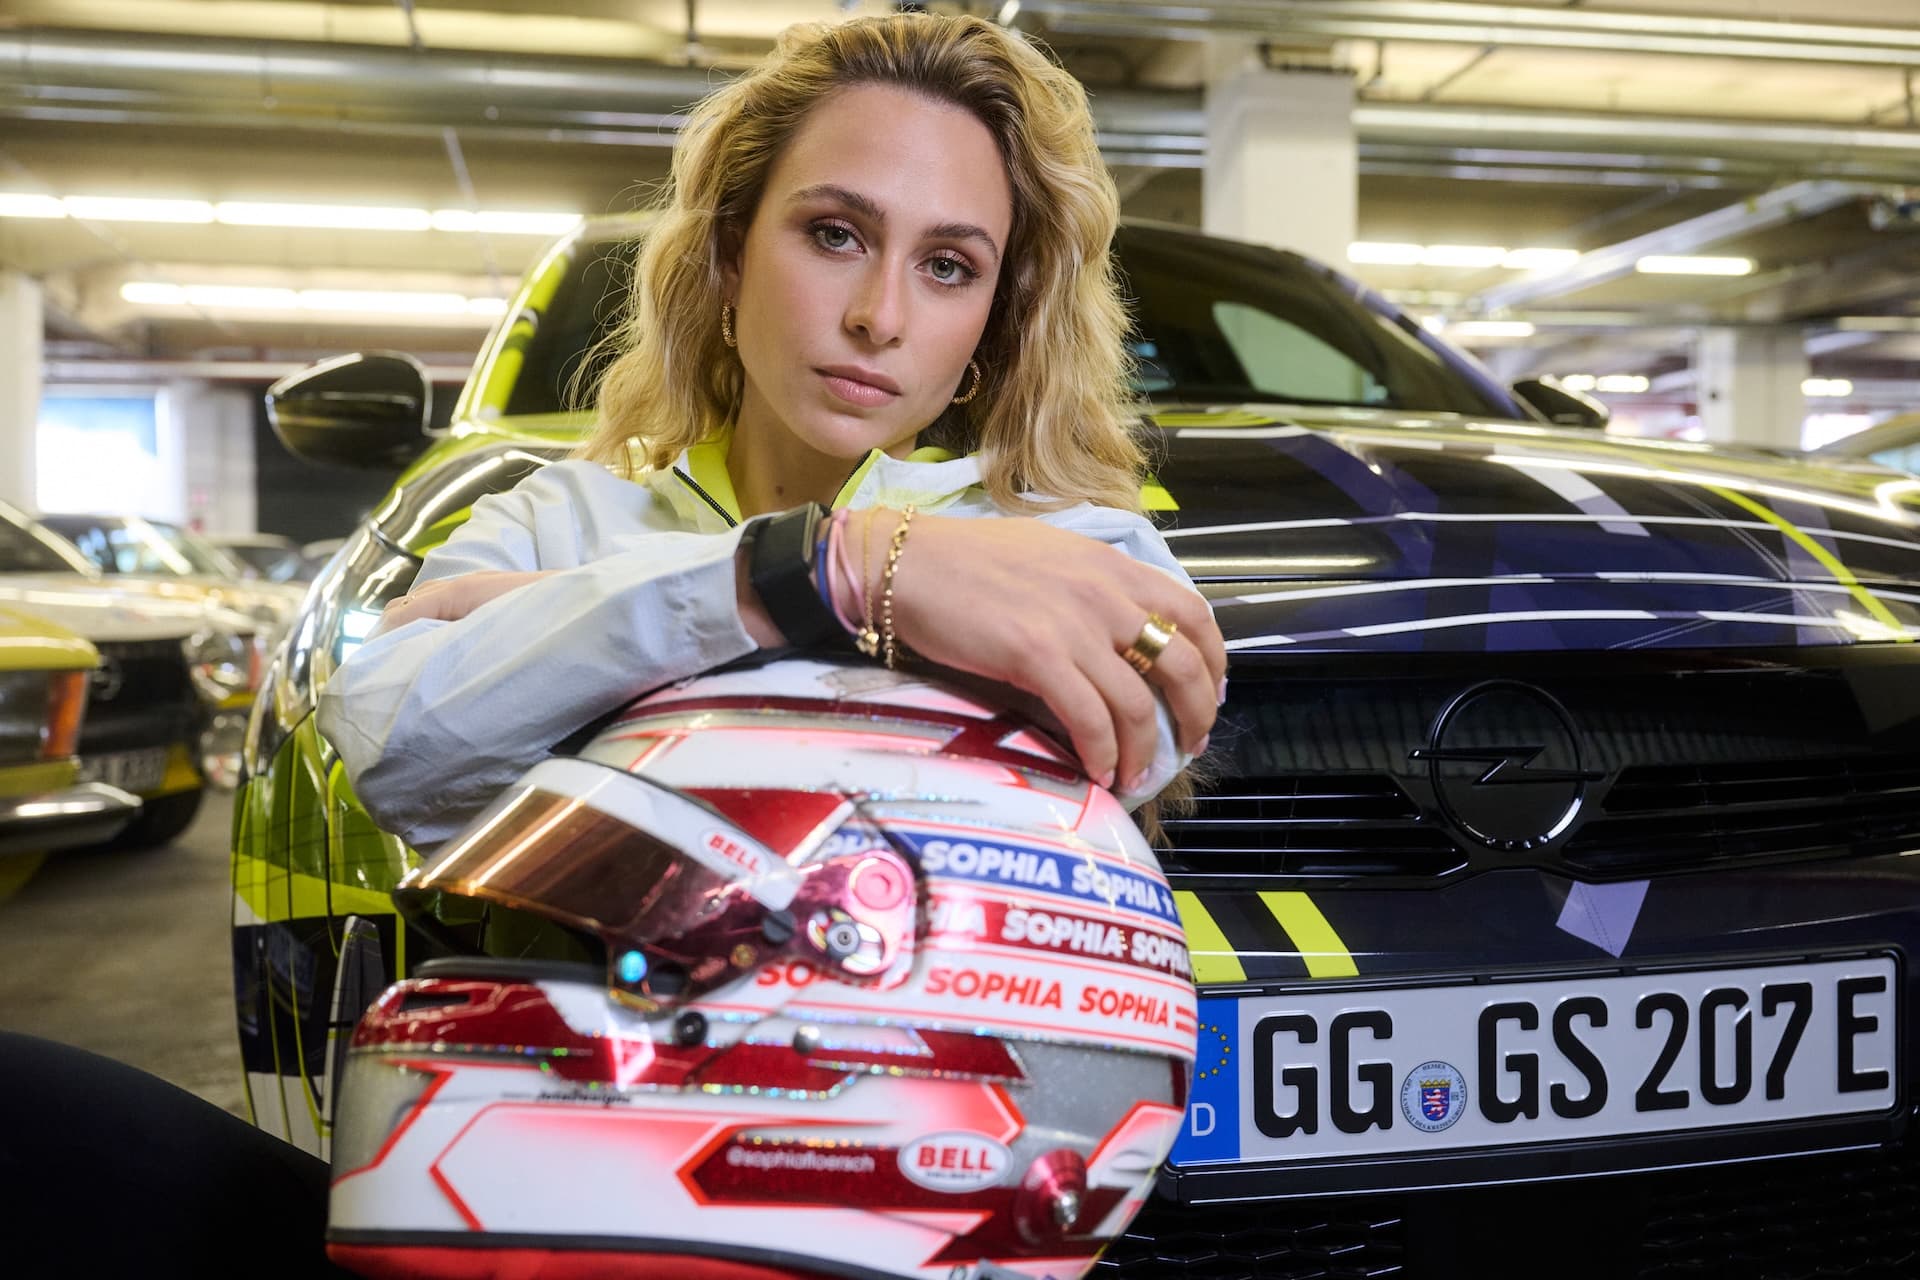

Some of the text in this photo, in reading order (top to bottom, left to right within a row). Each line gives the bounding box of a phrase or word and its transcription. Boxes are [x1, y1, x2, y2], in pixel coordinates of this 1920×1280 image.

[709, 834, 760, 874] BELL
[921, 840, 1062, 889] SOPHIA
[1072, 864, 1162, 913] SOPHIA
[1002, 909, 1123, 958] SOPHIA
[924, 968, 1062, 1010] SOPHIA
[1078, 986, 1168, 1027] SOPHIA
[1253, 975, 1889, 1138] GG GS 207 E
[1191, 1102, 1216, 1137] D
[918, 1145, 994, 1171] BELL
